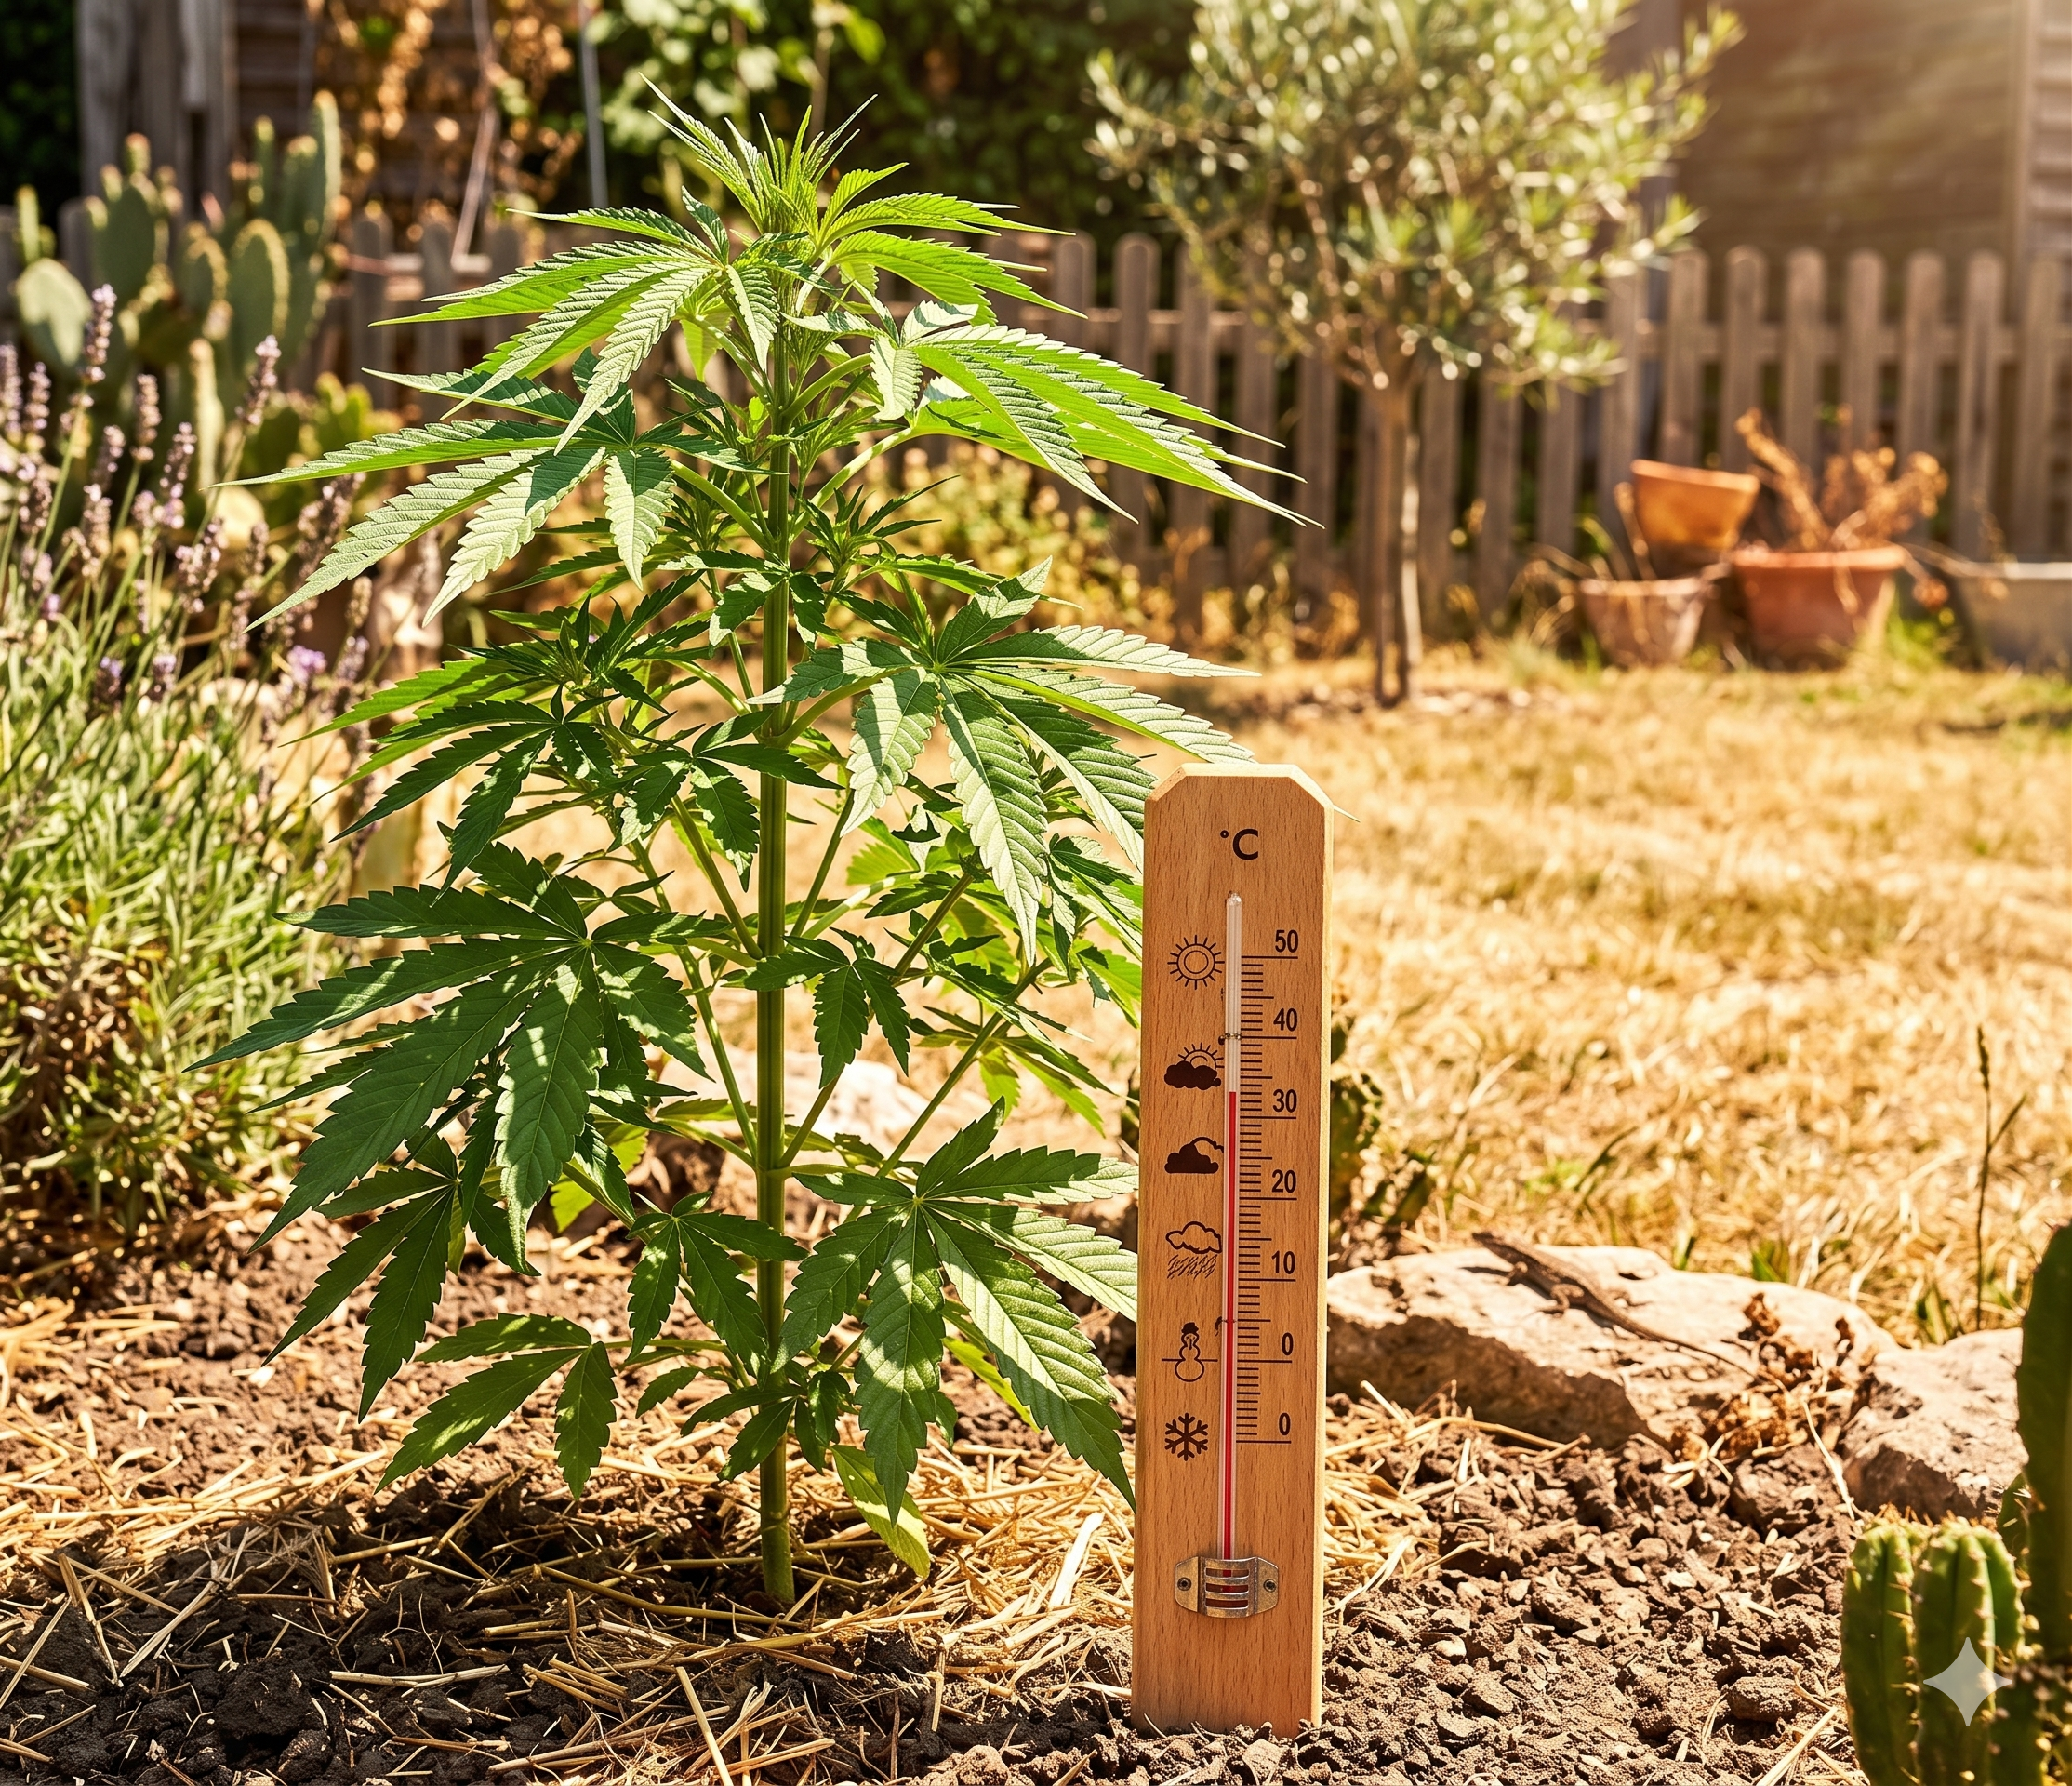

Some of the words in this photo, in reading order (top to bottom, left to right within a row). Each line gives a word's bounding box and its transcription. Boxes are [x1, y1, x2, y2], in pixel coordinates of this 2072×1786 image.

[1219, 828, 1259, 861] °C
[1274, 928, 1299, 953] 50
[1272, 1007, 1298, 1033] 40
[1272, 1088, 1298, 1113] 30
[1271, 1168, 1297, 1194] 20
[1270, 1249, 1296, 1275] 10
[1281, 1331, 1295, 1356] 0
[1278, 1412, 1292, 1436] 0
